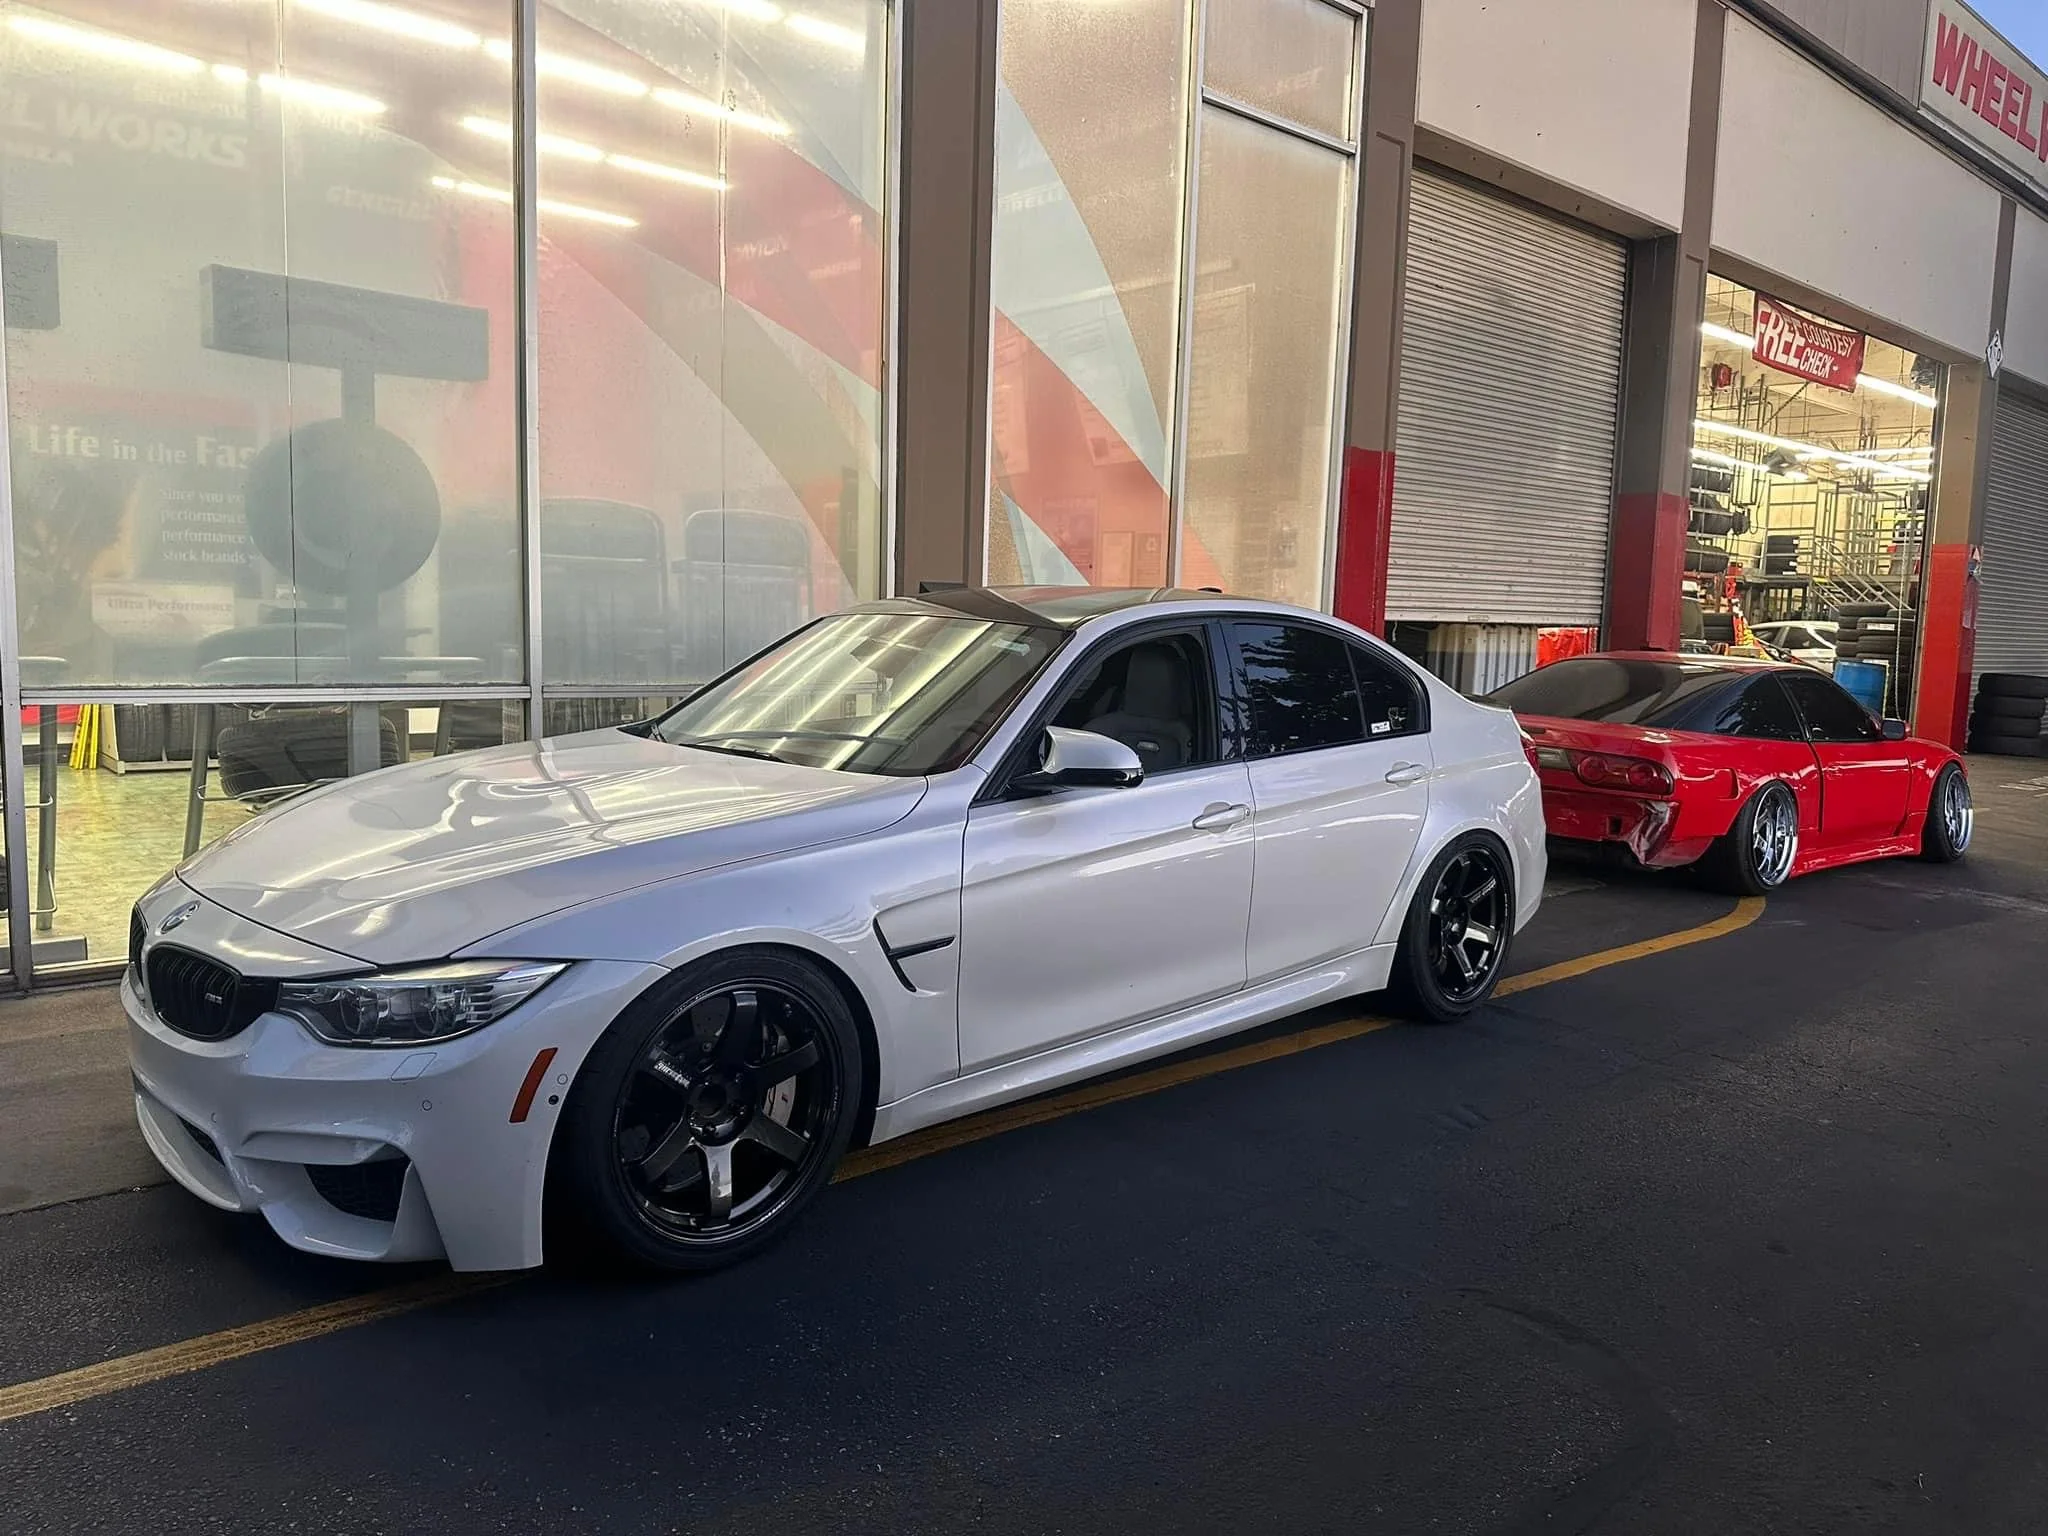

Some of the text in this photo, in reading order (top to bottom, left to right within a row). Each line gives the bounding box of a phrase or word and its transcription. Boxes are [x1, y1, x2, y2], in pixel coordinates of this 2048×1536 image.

[1932, 12, 2038, 153] WHEEL
[55, 99, 248, 168] WORKS
[1754, 299, 1856, 369] FREE COURTESY
[1800, 346, 1834, 379] CHECK
[28, 424, 258, 469] Life in the Fas
[161, 528, 247, 544] performance
[106, 598, 234, 613] Ultra Performance
